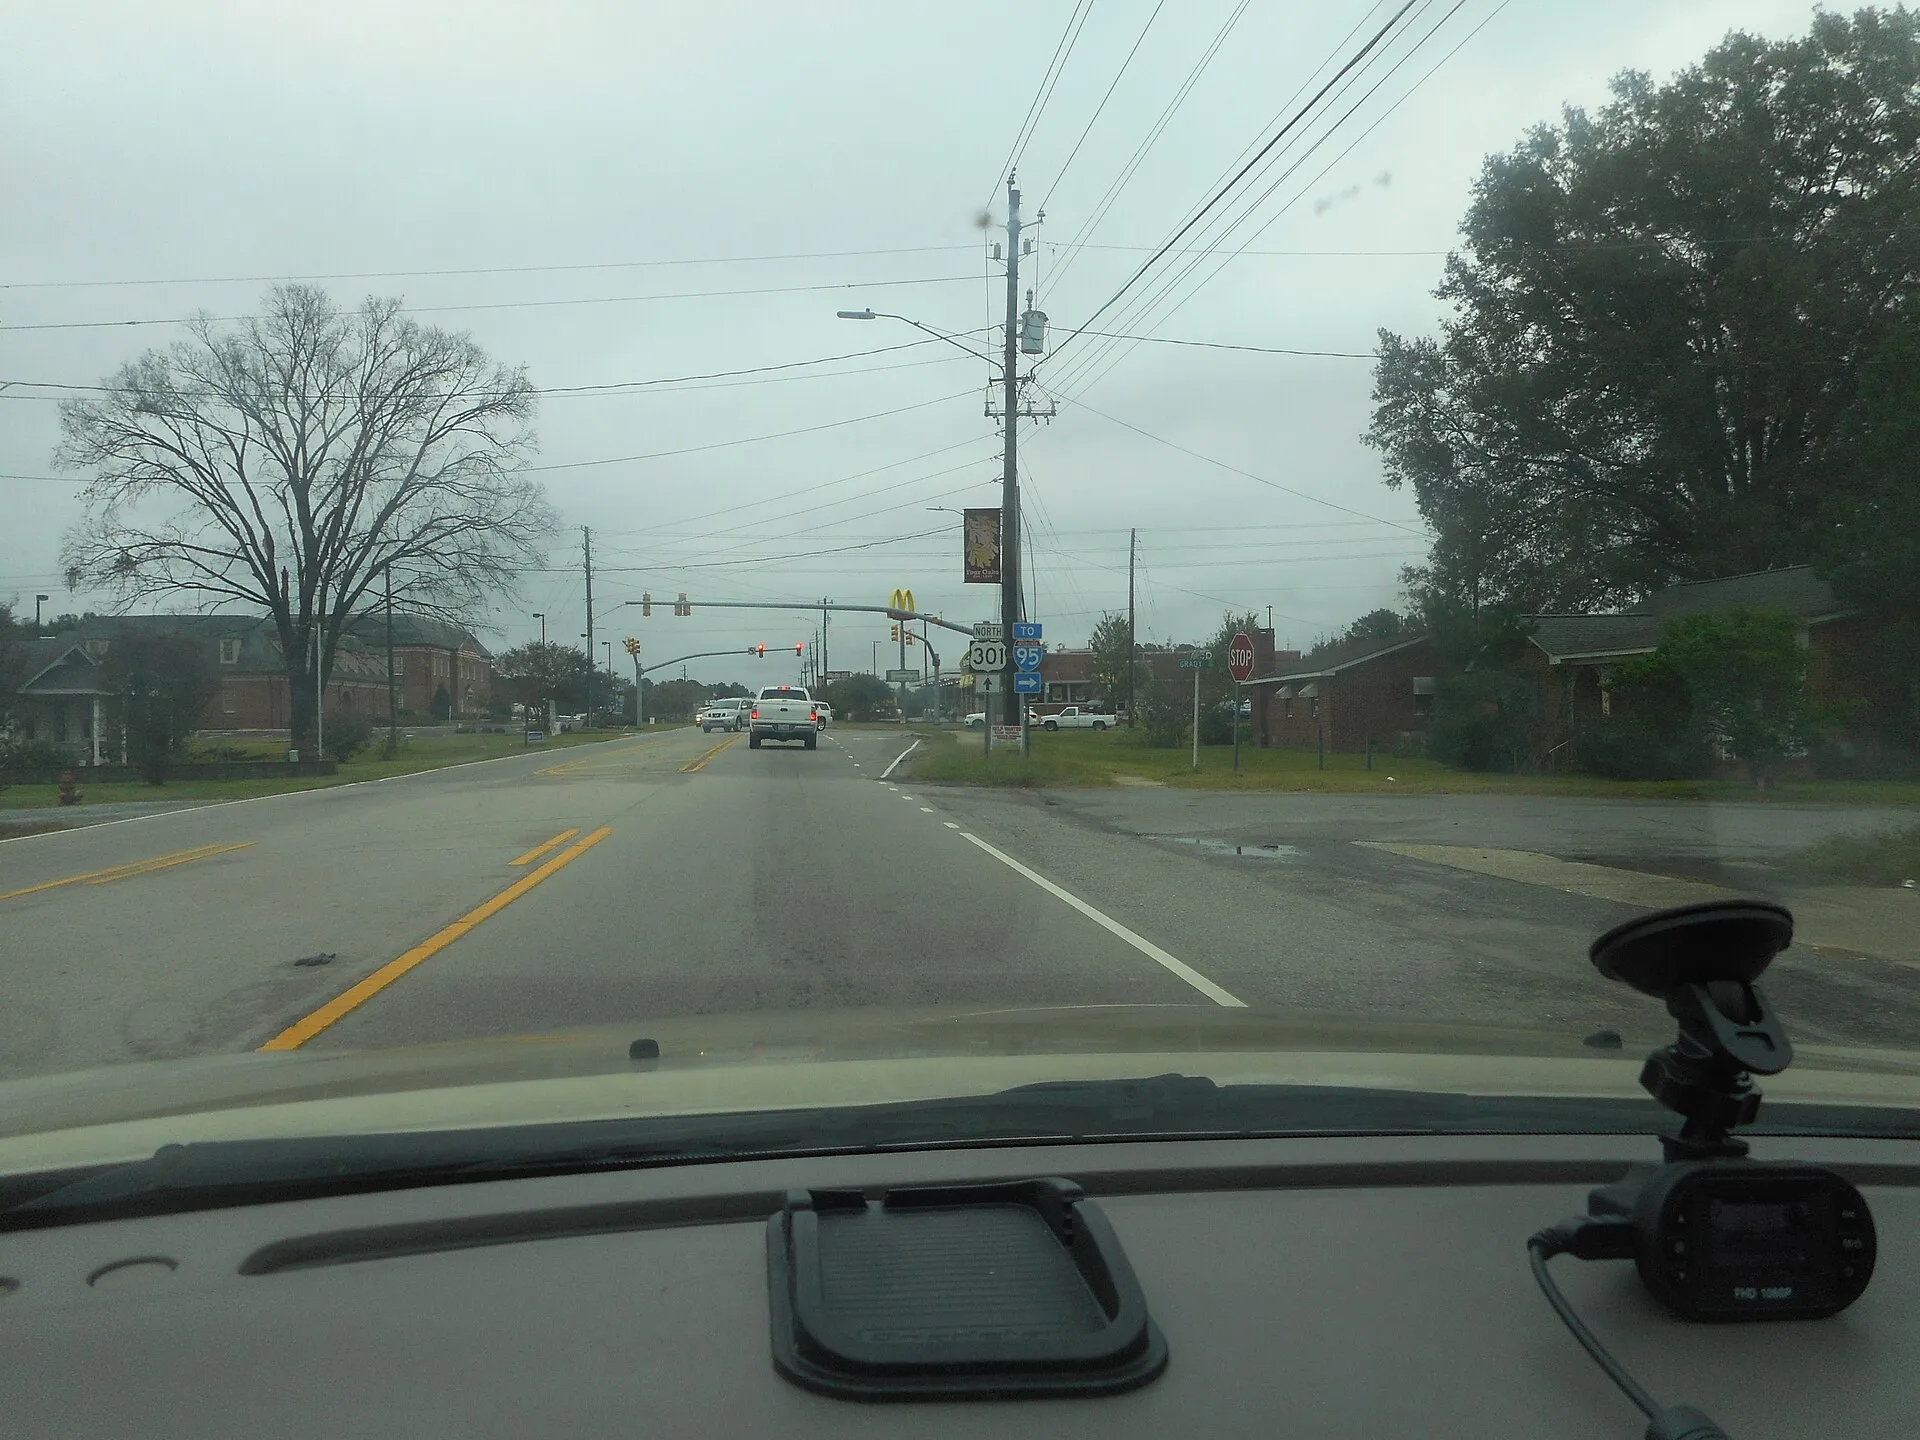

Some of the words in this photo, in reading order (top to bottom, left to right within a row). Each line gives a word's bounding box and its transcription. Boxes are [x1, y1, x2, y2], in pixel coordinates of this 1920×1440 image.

[975, 627, 1002, 636] NORTH
[1020, 626, 1035, 636] TO
[973, 647, 1004, 665] 301
[1016, 647, 1039, 665] 95
[1230, 649, 1252, 667] STOP
